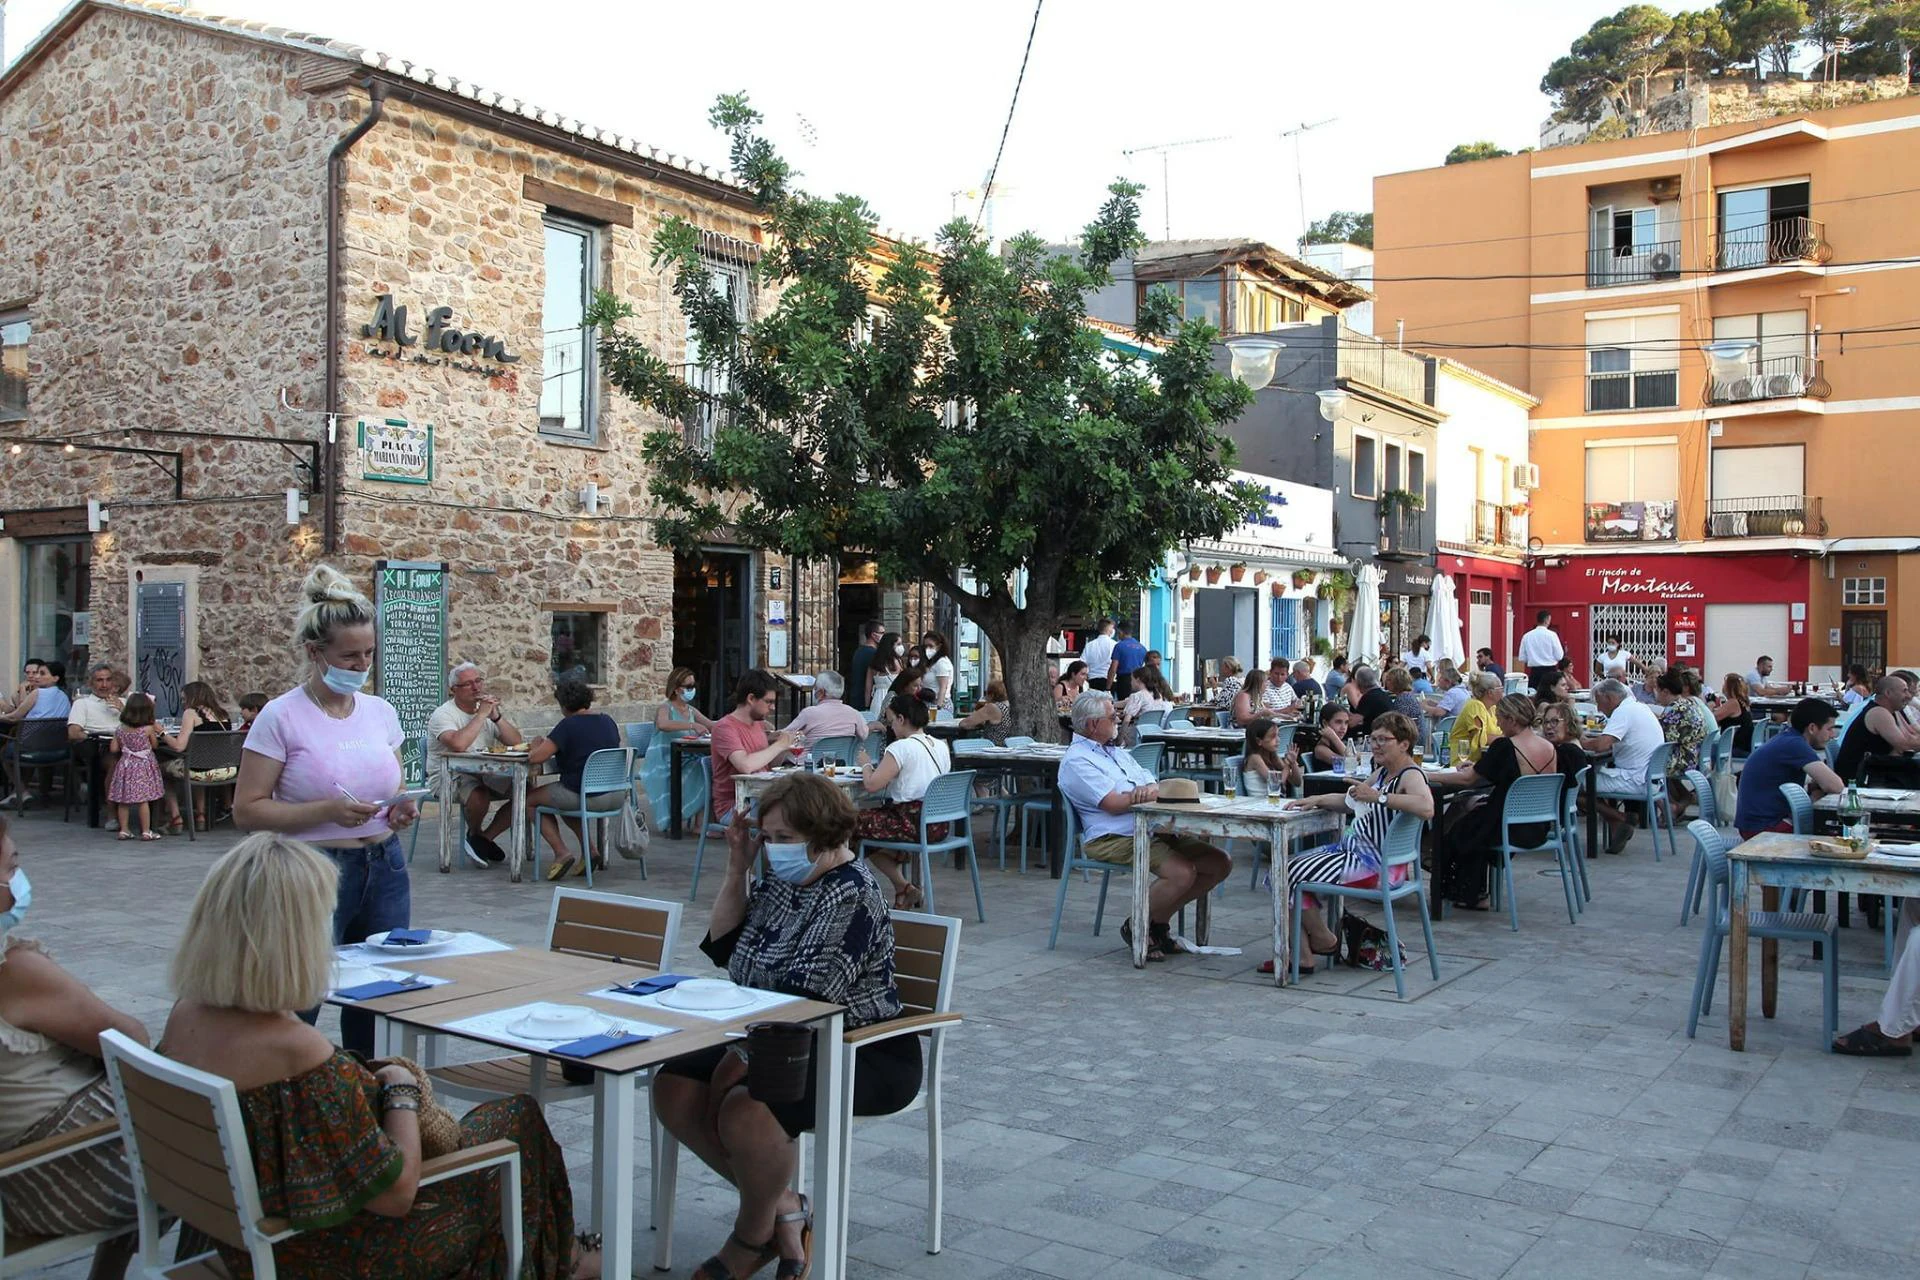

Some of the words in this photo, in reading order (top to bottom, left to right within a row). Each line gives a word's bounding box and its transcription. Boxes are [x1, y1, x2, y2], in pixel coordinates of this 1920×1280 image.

[361, 294, 418, 346] Al
[425, 306, 521, 362] Forn
[381, 441, 413, 453] PLAÇA
[373, 451, 400, 464] MARIANA
[1585, 568, 1596, 576] El
[1598, 568, 1627, 576] rincón
[1629, 568, 1642, 576] de
[1602, 576, 1694, 594] Montava
